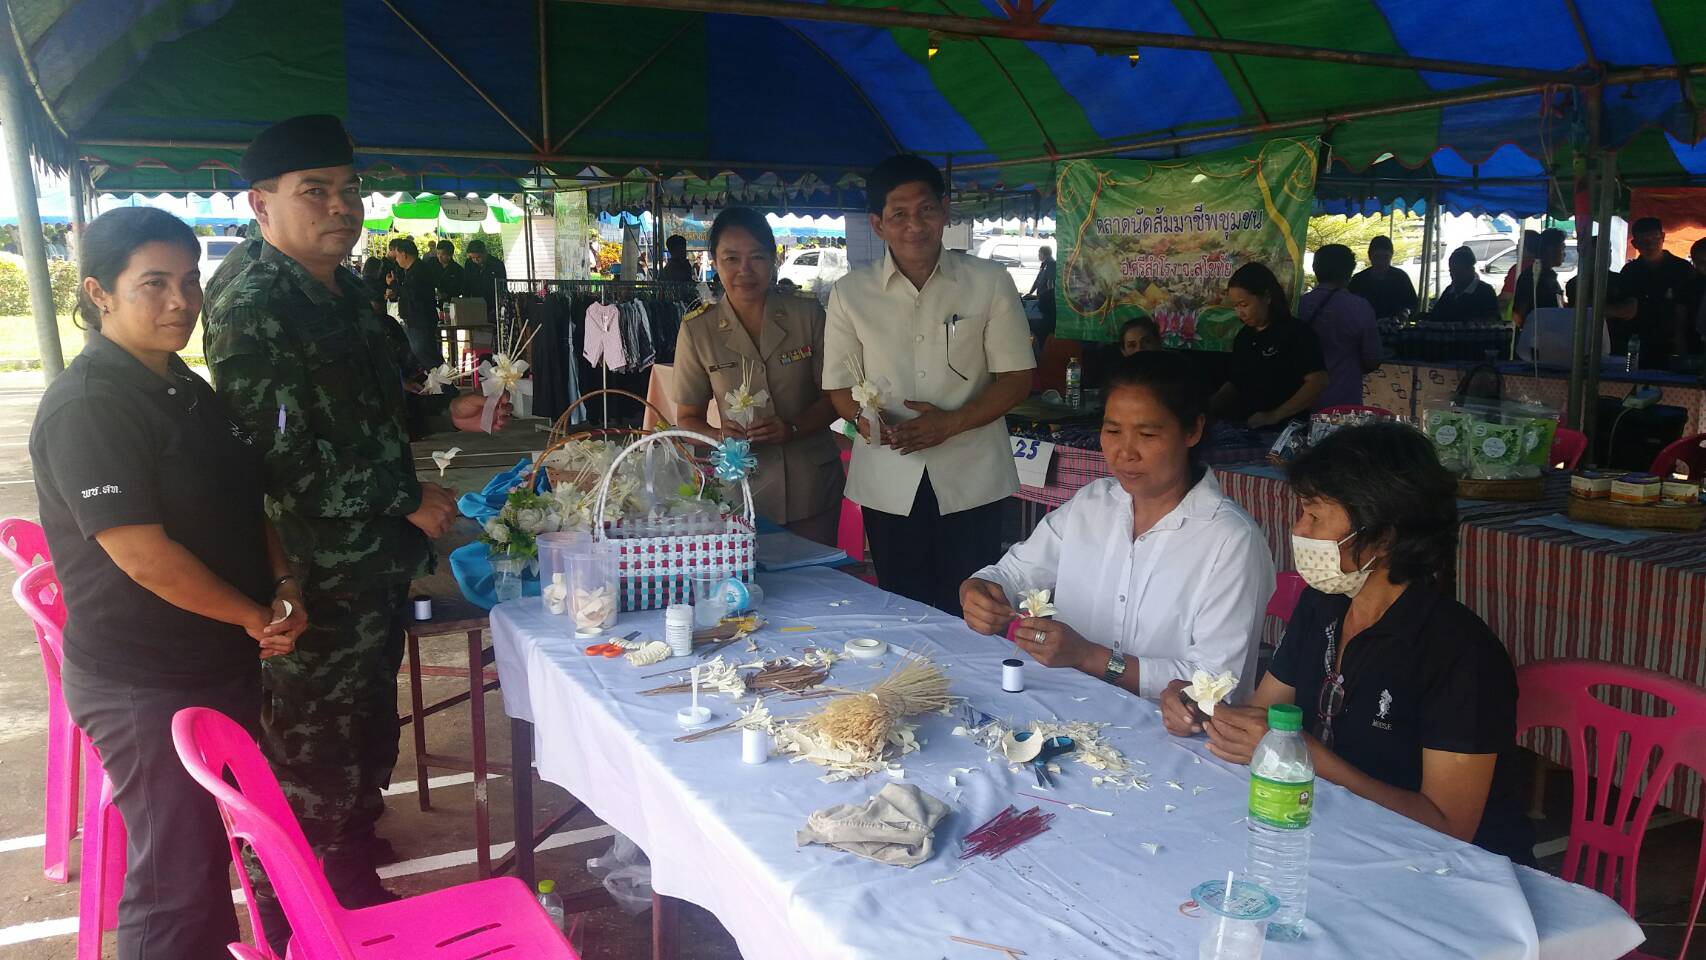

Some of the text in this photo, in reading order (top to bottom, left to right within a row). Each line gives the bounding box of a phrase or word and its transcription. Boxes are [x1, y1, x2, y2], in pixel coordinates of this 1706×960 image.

[1096, 204, 1263, 241] ตลาดนัดสัมมาชีพชุมชน
[1013, 439, 1040, 460] 25
